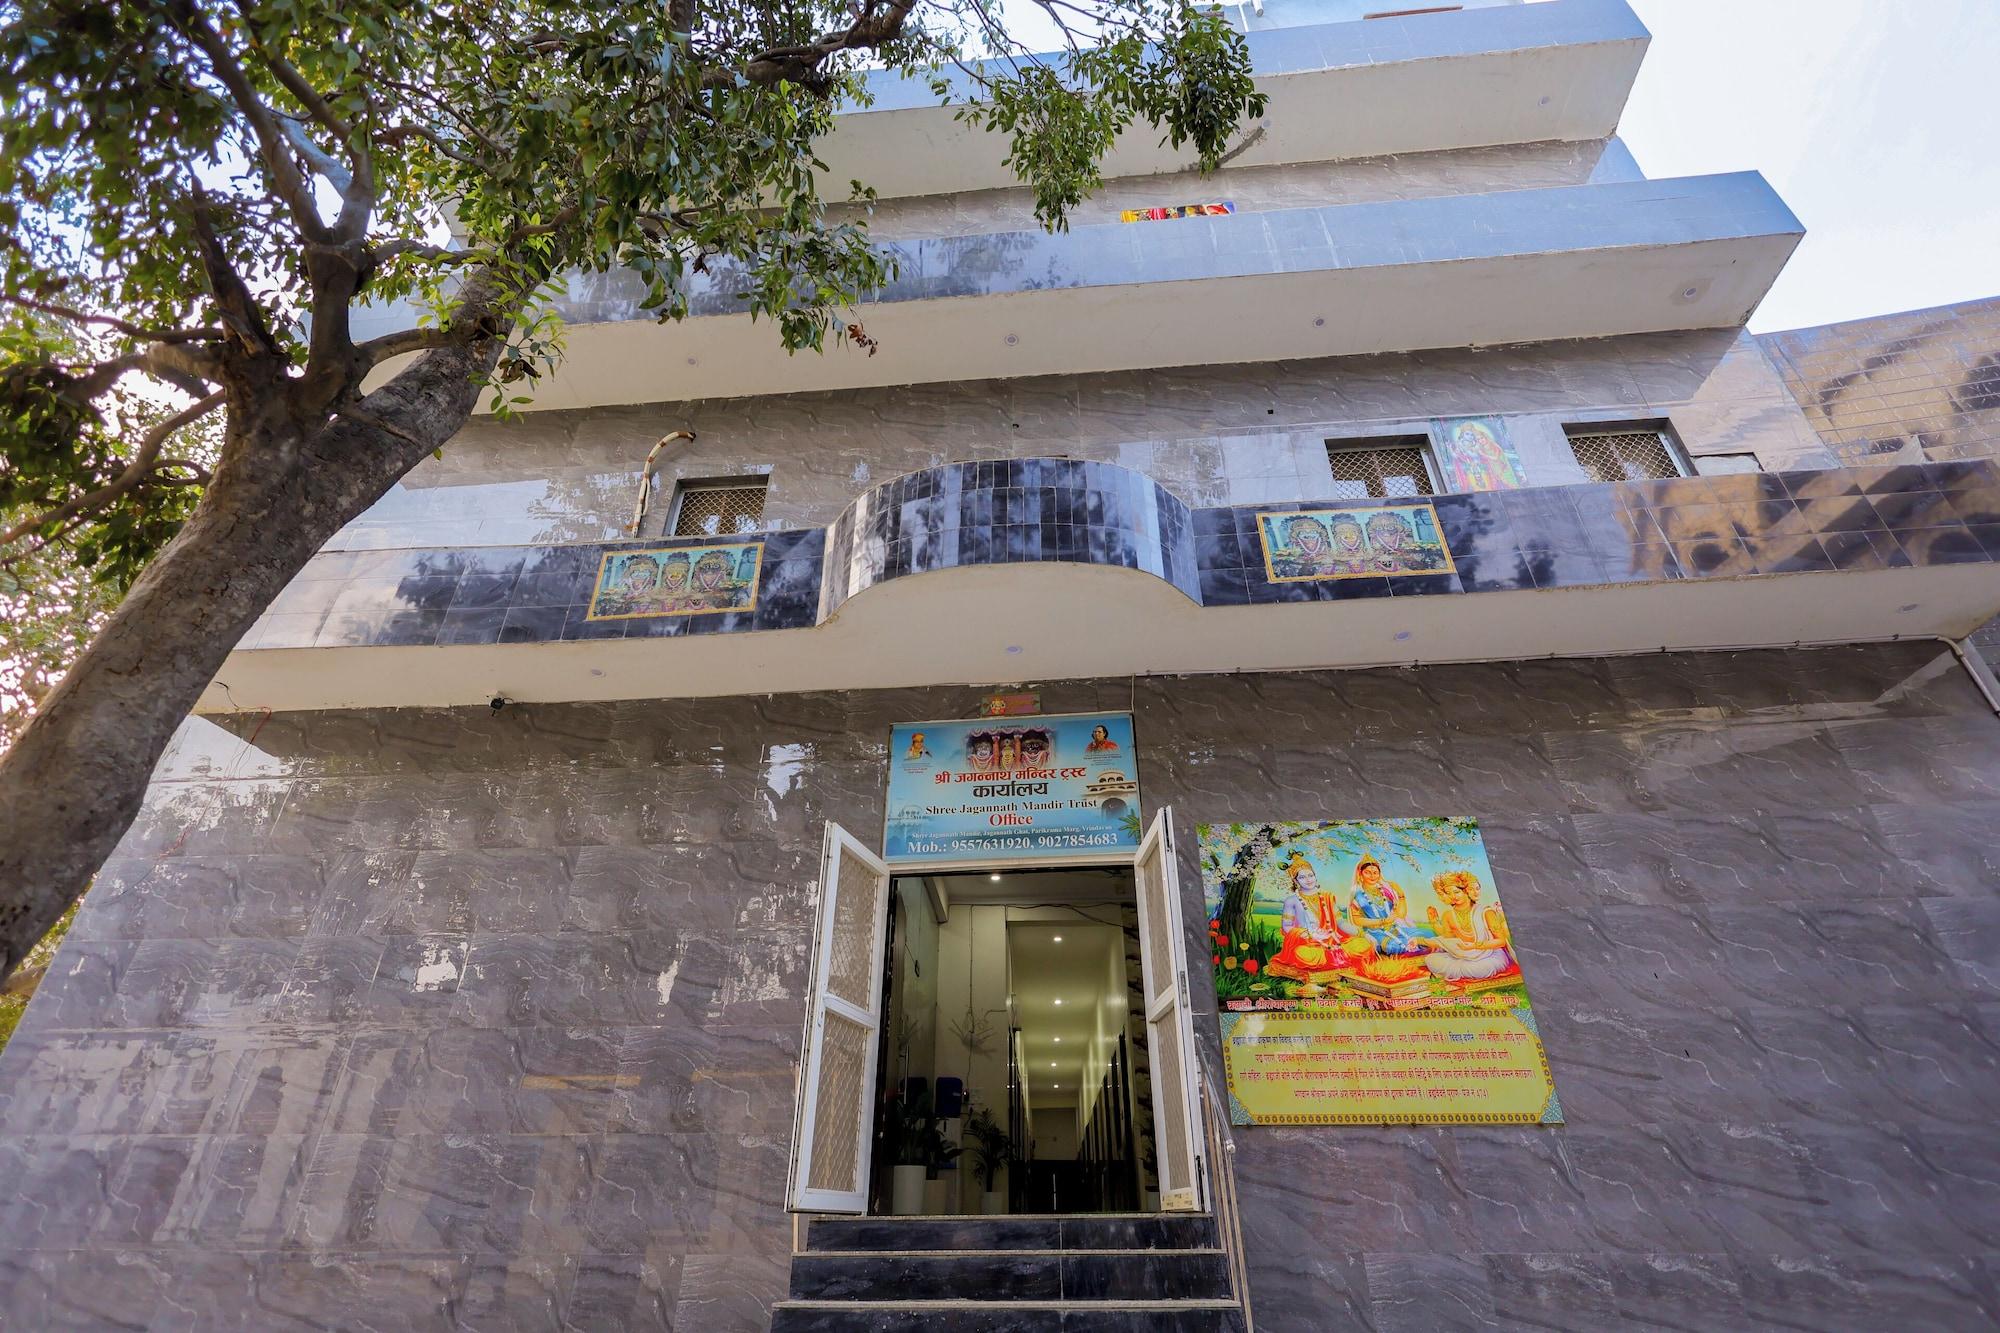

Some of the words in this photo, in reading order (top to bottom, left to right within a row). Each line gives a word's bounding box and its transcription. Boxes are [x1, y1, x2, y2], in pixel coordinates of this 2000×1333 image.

[935, 770, 950, 784] श्री
[954, 770, 1011, 783] जगन्नाथ
[1016, 766, 1057, 780] मन्दिर
[1059, 767, 1087, 780] ट्रस्ट
[973, 781, 1048, 798] कार्यालय
[925, 805, 957, 815] Shree
[959, 802, 1018, 814] Jagannath
[1022, 799, 1064, 810] Mandir
[1067, 799, 1097, 809] Trust
[989, 813, 1033, 826] Office
[951, 837, 1035, 852] 9557631920,
[1038, 832, 1118, 848] 9027854683
